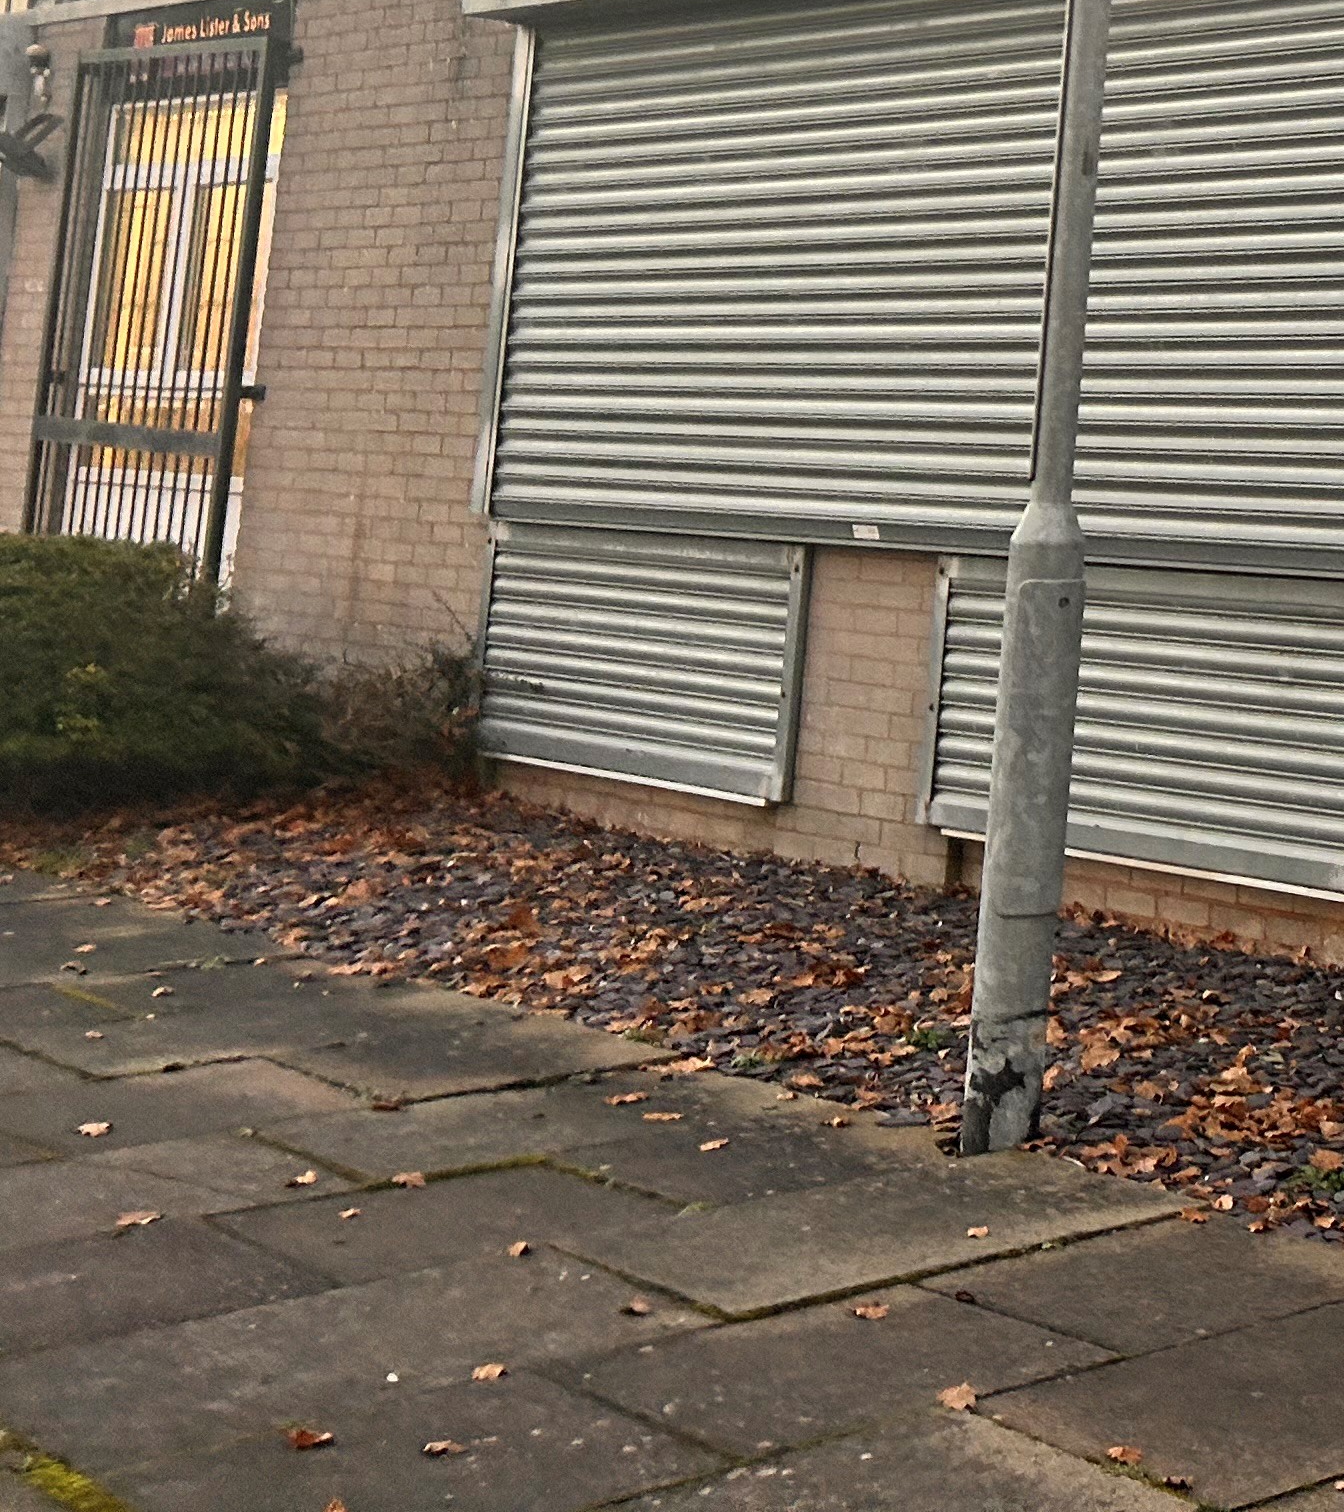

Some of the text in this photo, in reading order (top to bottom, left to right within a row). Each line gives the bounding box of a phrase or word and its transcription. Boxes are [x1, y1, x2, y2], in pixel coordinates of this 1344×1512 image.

[161, 10, 271, 44] James Lister & Sons
